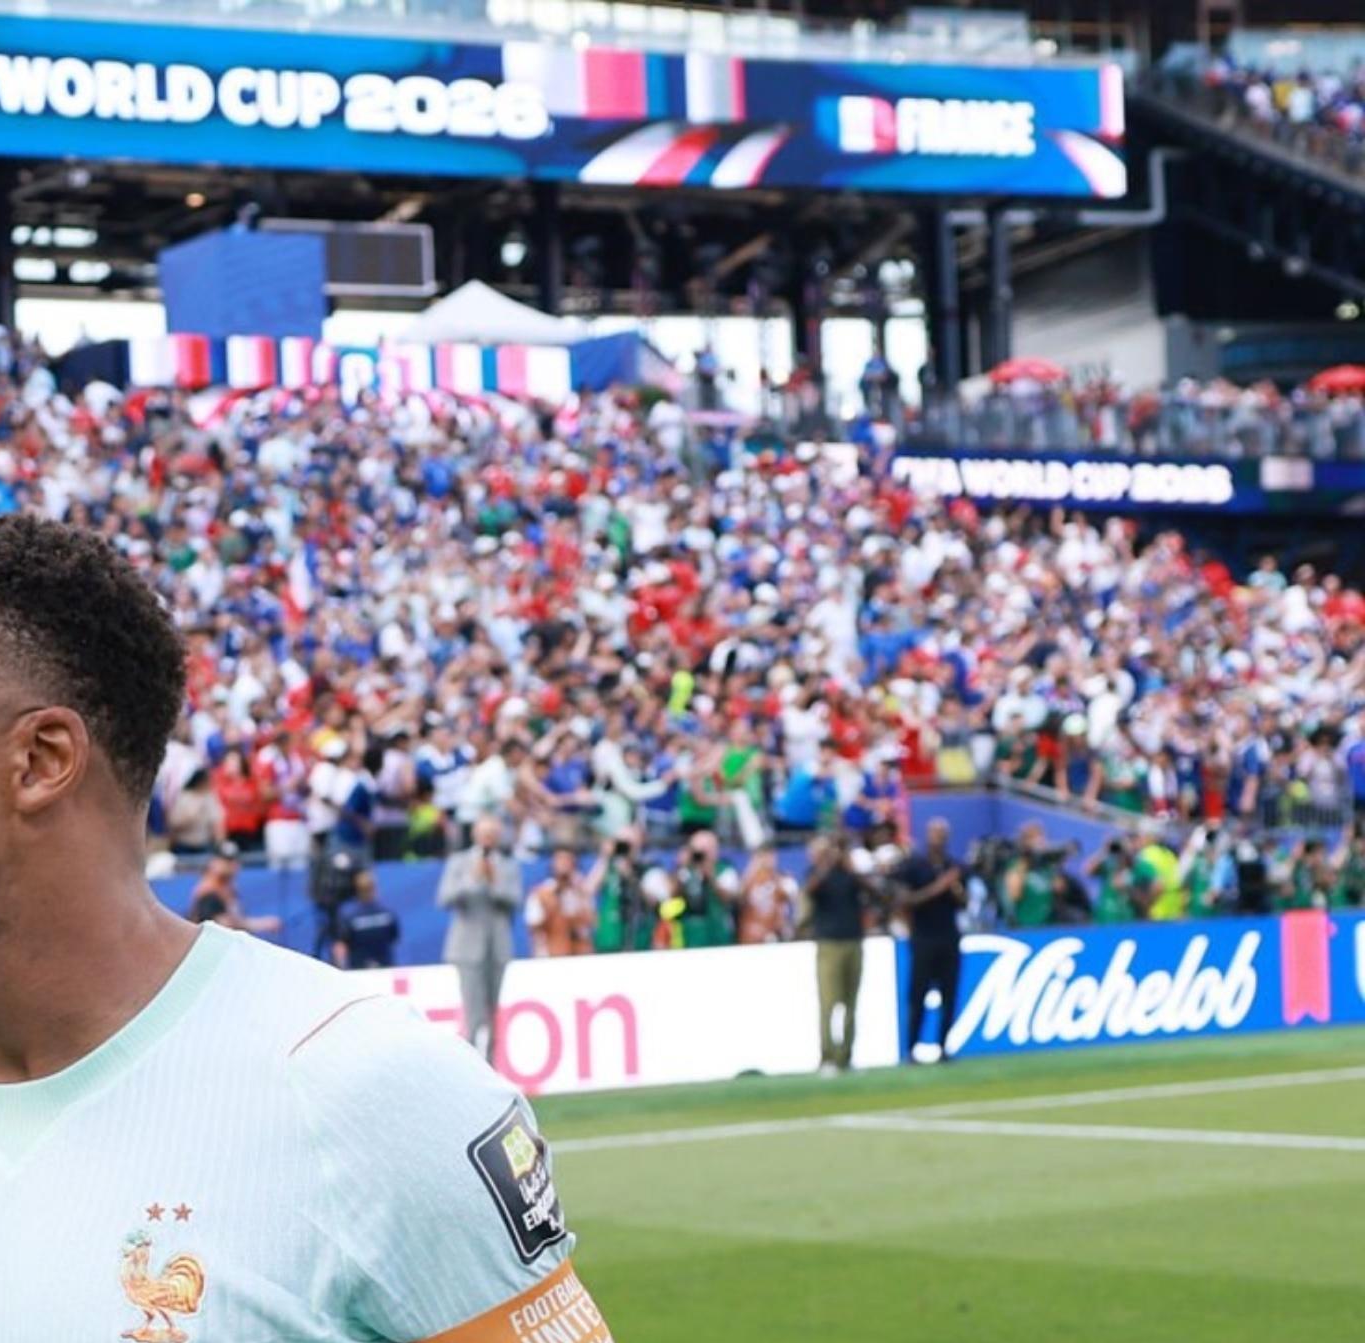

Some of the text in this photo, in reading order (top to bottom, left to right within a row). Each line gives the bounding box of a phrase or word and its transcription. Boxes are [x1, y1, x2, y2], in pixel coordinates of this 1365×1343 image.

[218, 67, 341, 129] CUP
[343, 73, 550, 139] 2026
[945, 930, 1262, 1056] Michelob
